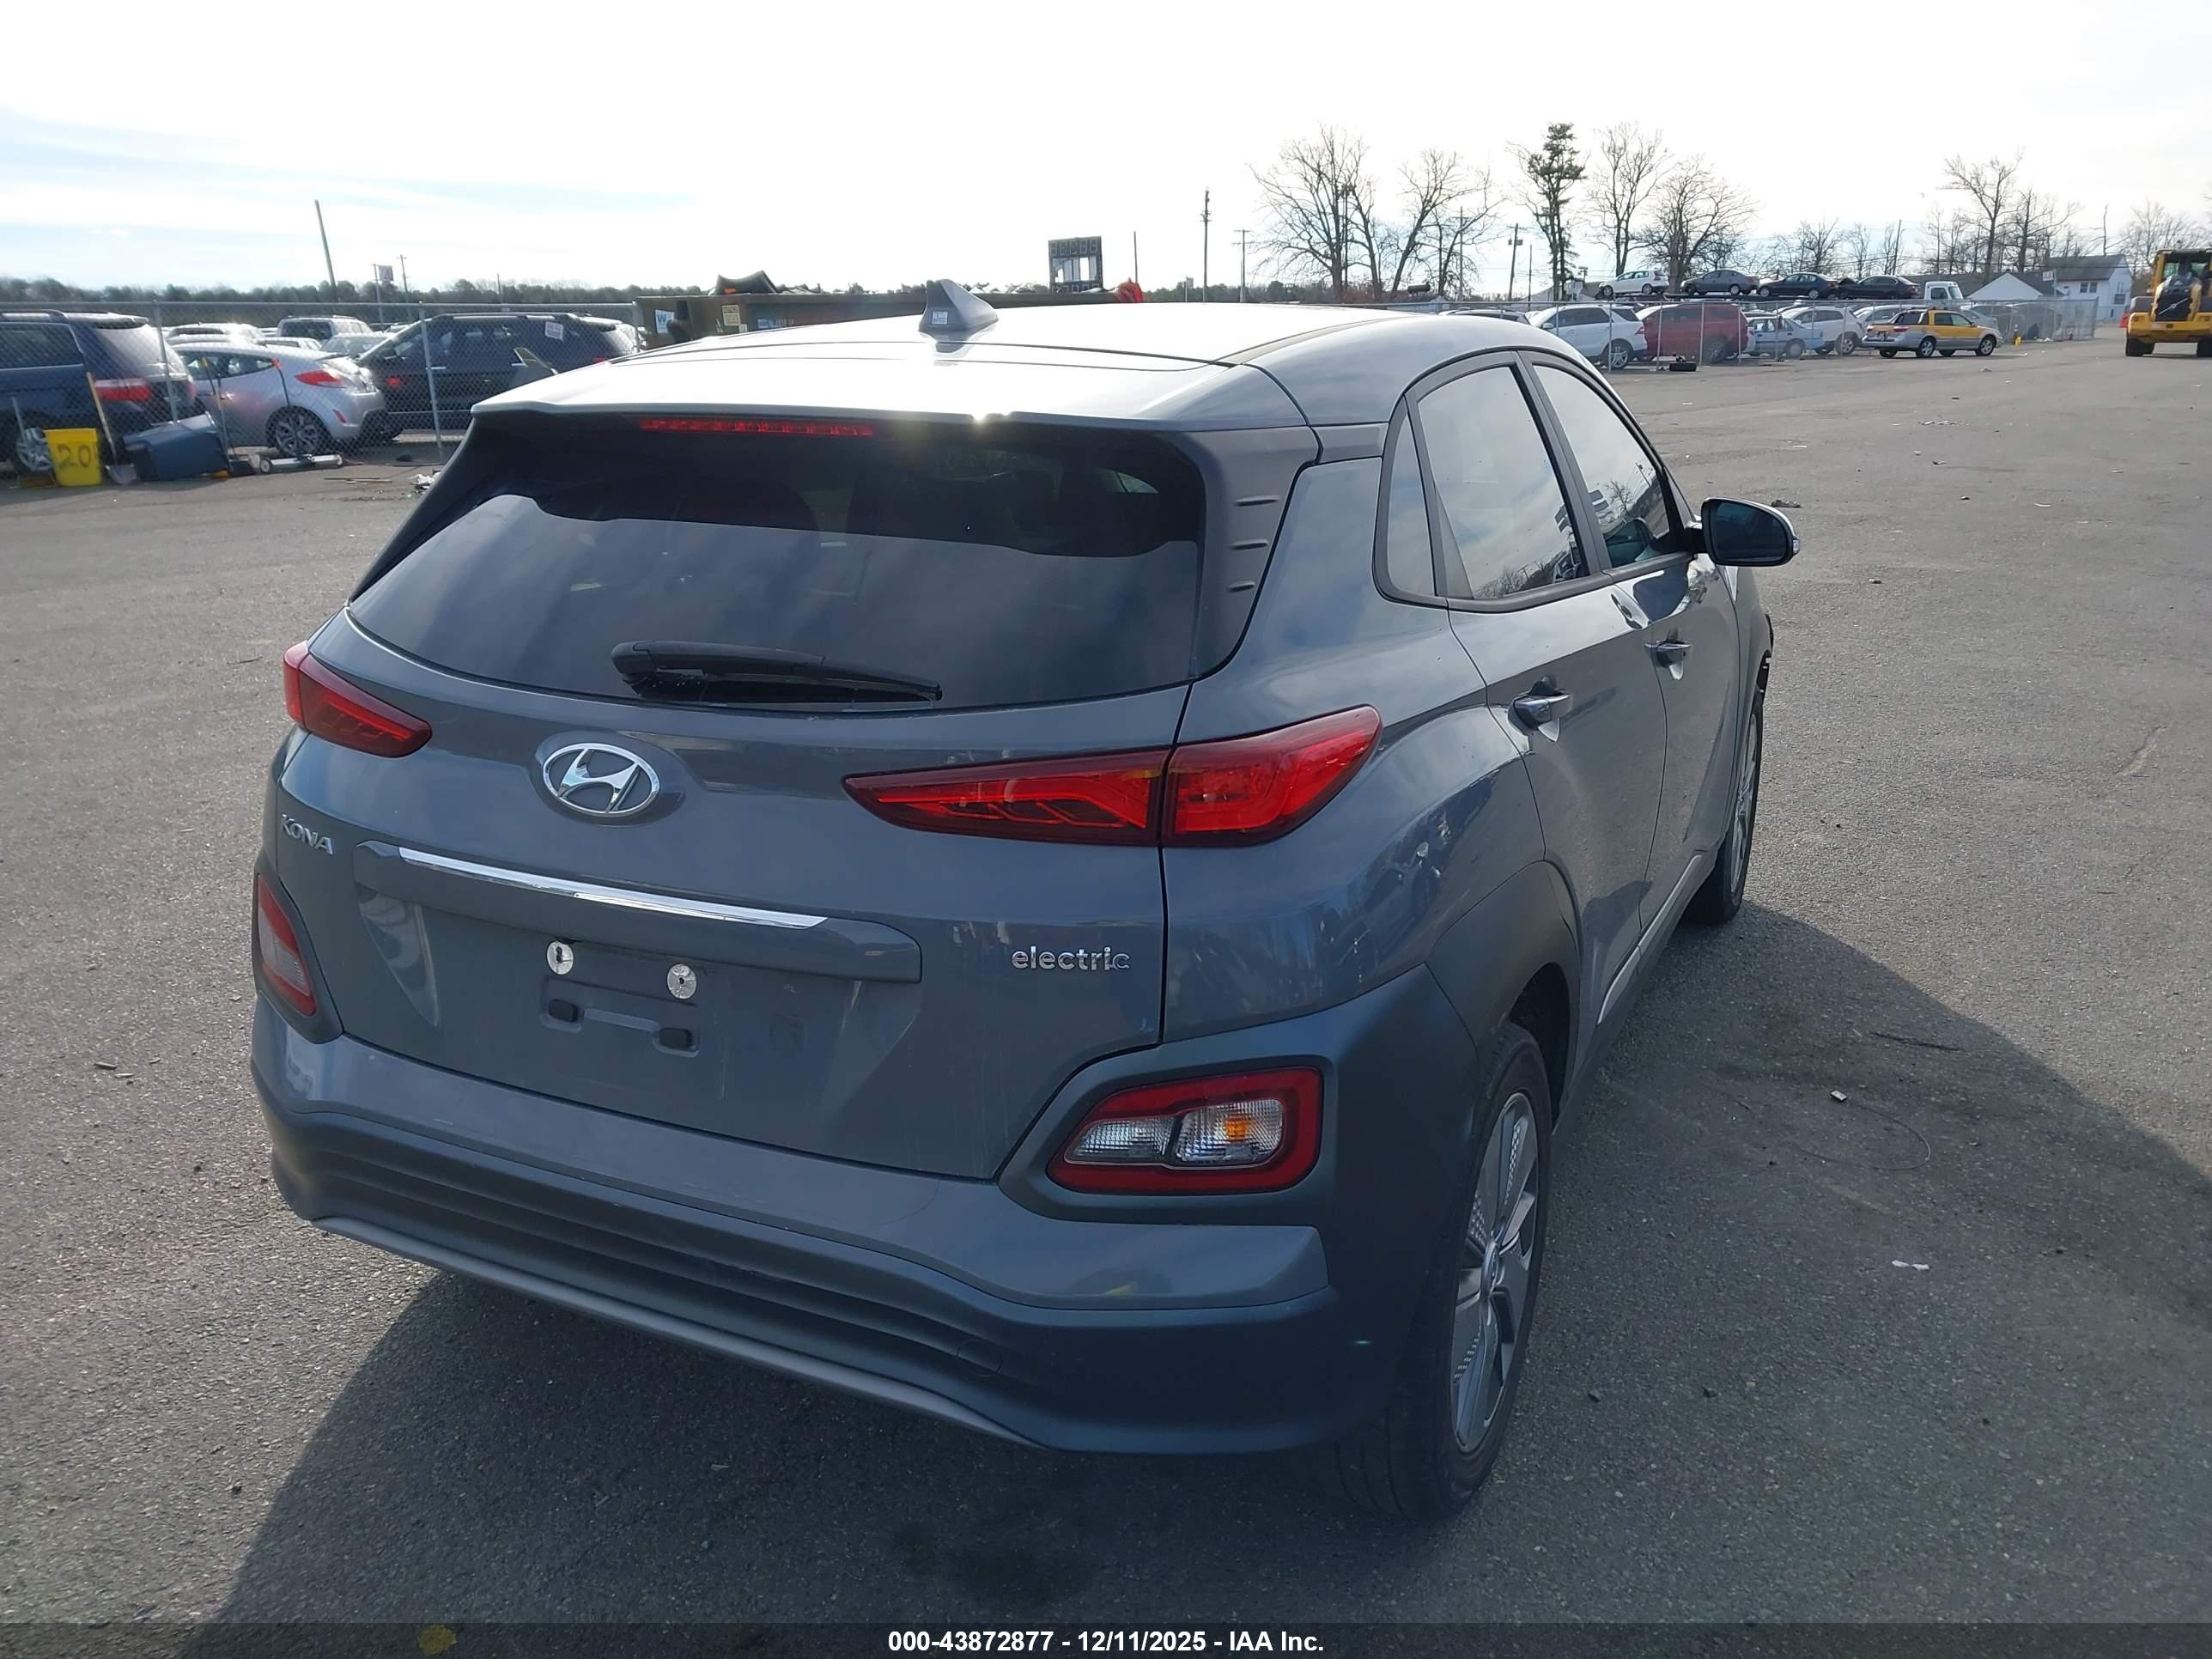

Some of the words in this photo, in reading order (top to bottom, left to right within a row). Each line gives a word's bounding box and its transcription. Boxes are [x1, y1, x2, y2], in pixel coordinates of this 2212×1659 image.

[57, 443, 92, 468] 20
[282, 813, 333, 855] KONA
[1012, 945, 1130, 971] electric
